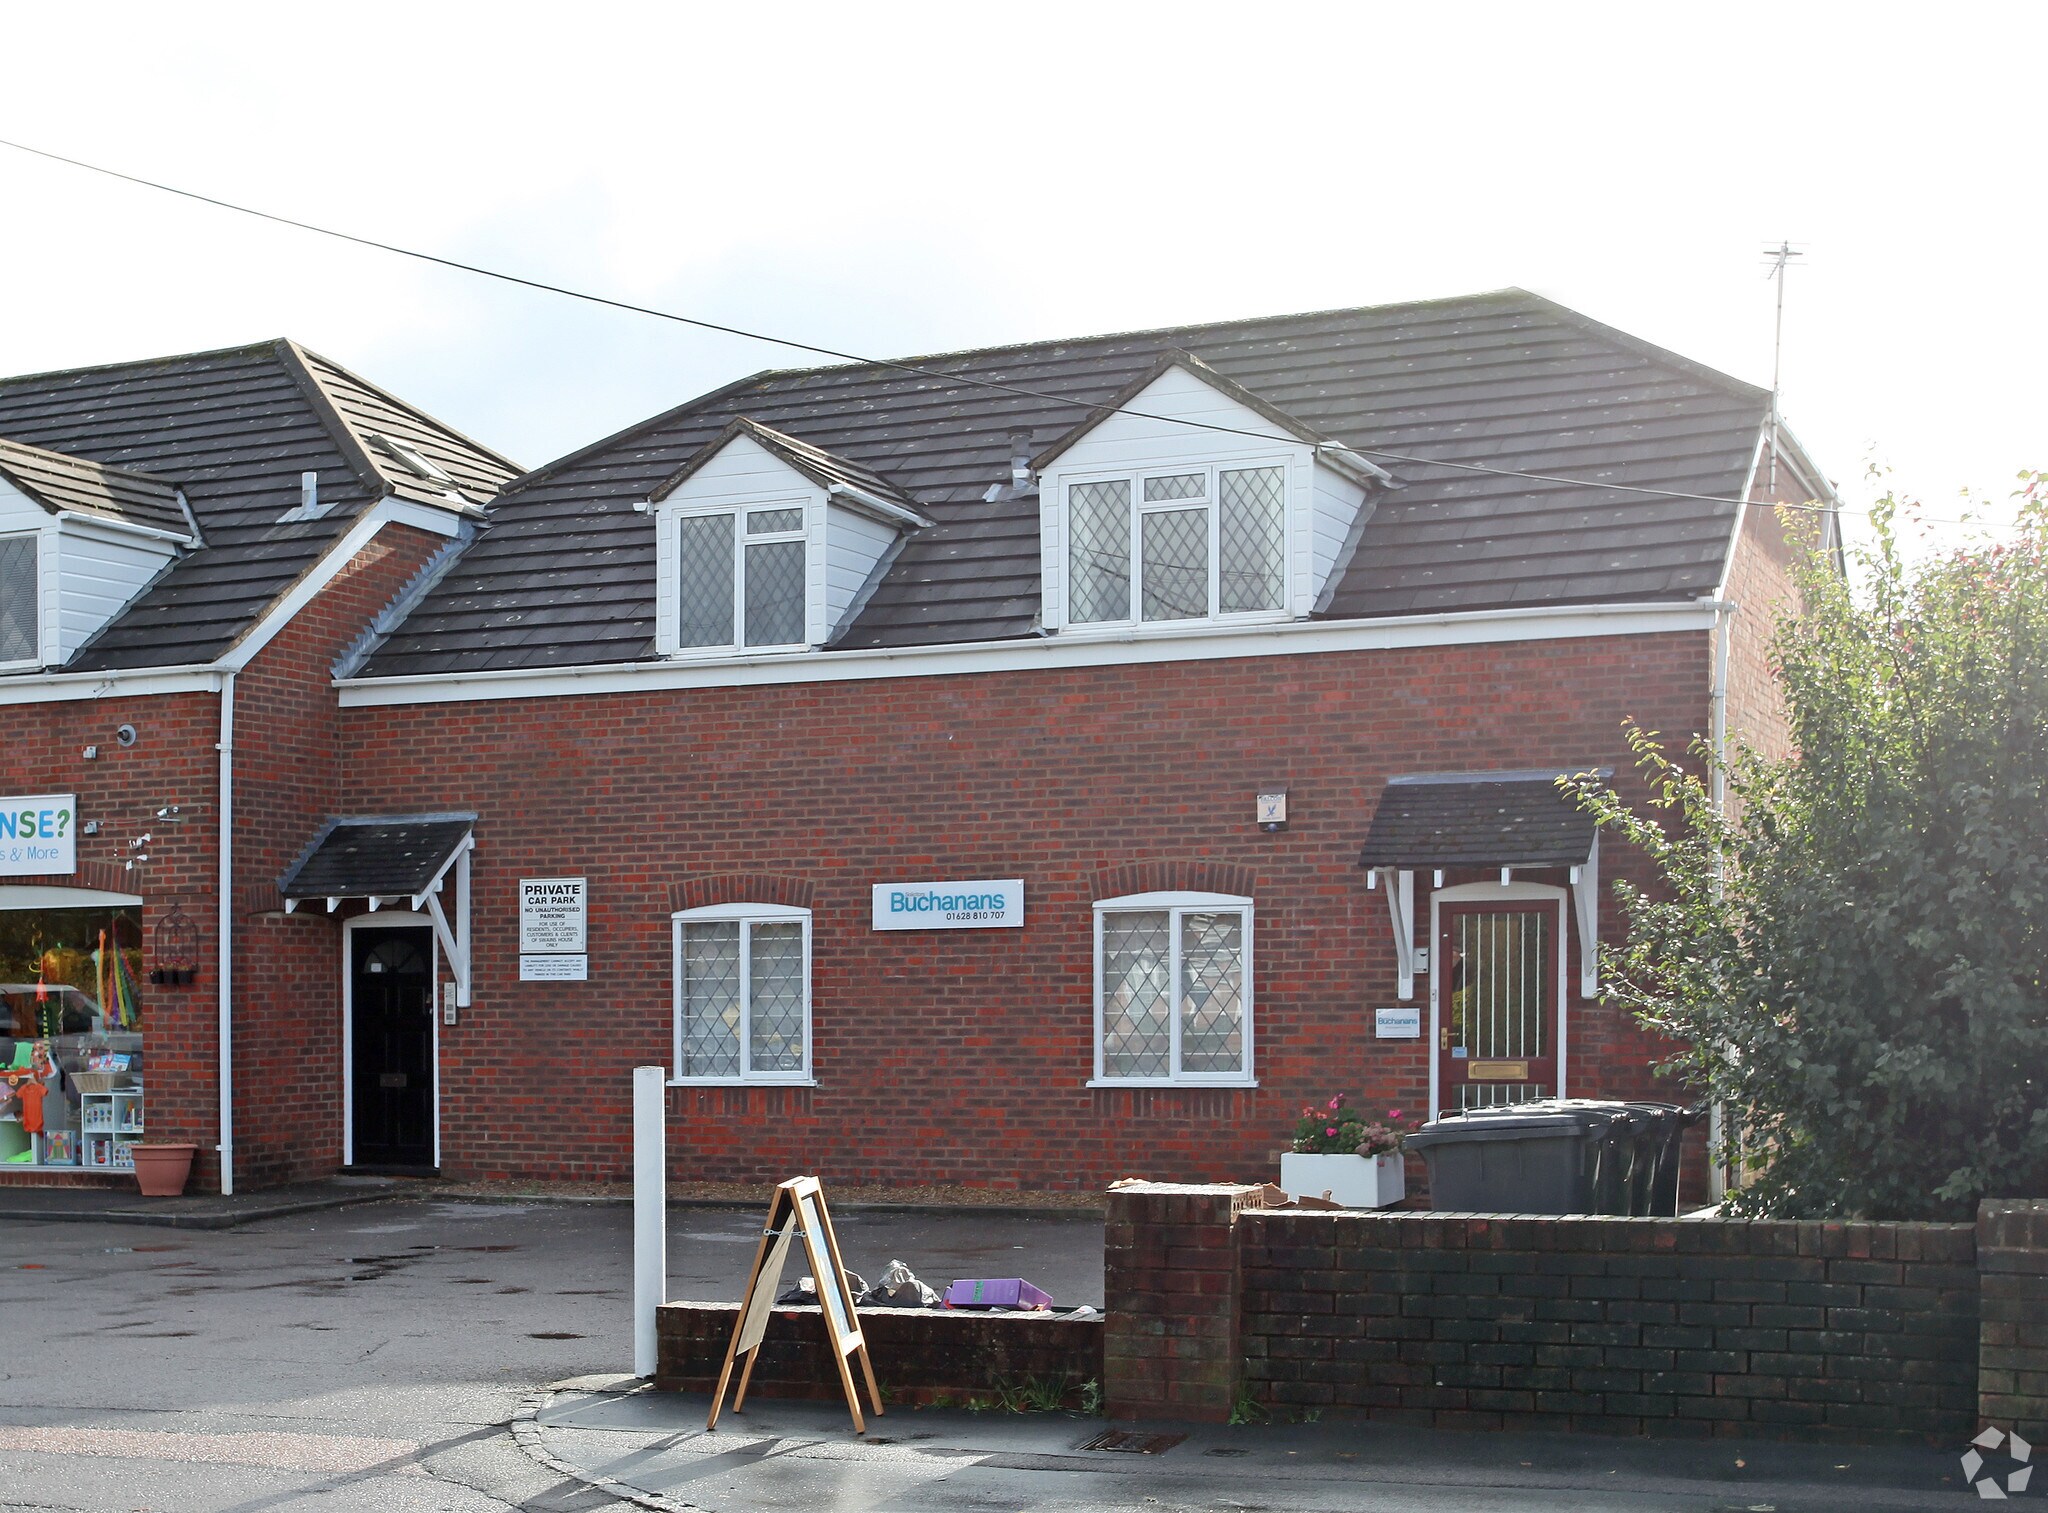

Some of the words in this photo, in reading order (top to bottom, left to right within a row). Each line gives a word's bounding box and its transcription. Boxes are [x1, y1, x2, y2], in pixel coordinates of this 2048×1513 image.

[0, 809, 71, 840] NSE?
[9, 847, 24, 862] &
[27, 846, 59, 860] More
[525, 884, 581, 895] PRIVATE
[528, 896, 547, 905] CAR
[551, 896, 576, 904] PARK
[890, 890, 1005, 912] Buchanans
[946, 912, 971, 921] 01628
[972, 911, 988, 920] 810
[990, 911, 1005, 920] 707
[1377, 1017, 1418, 1025] Buchanans
